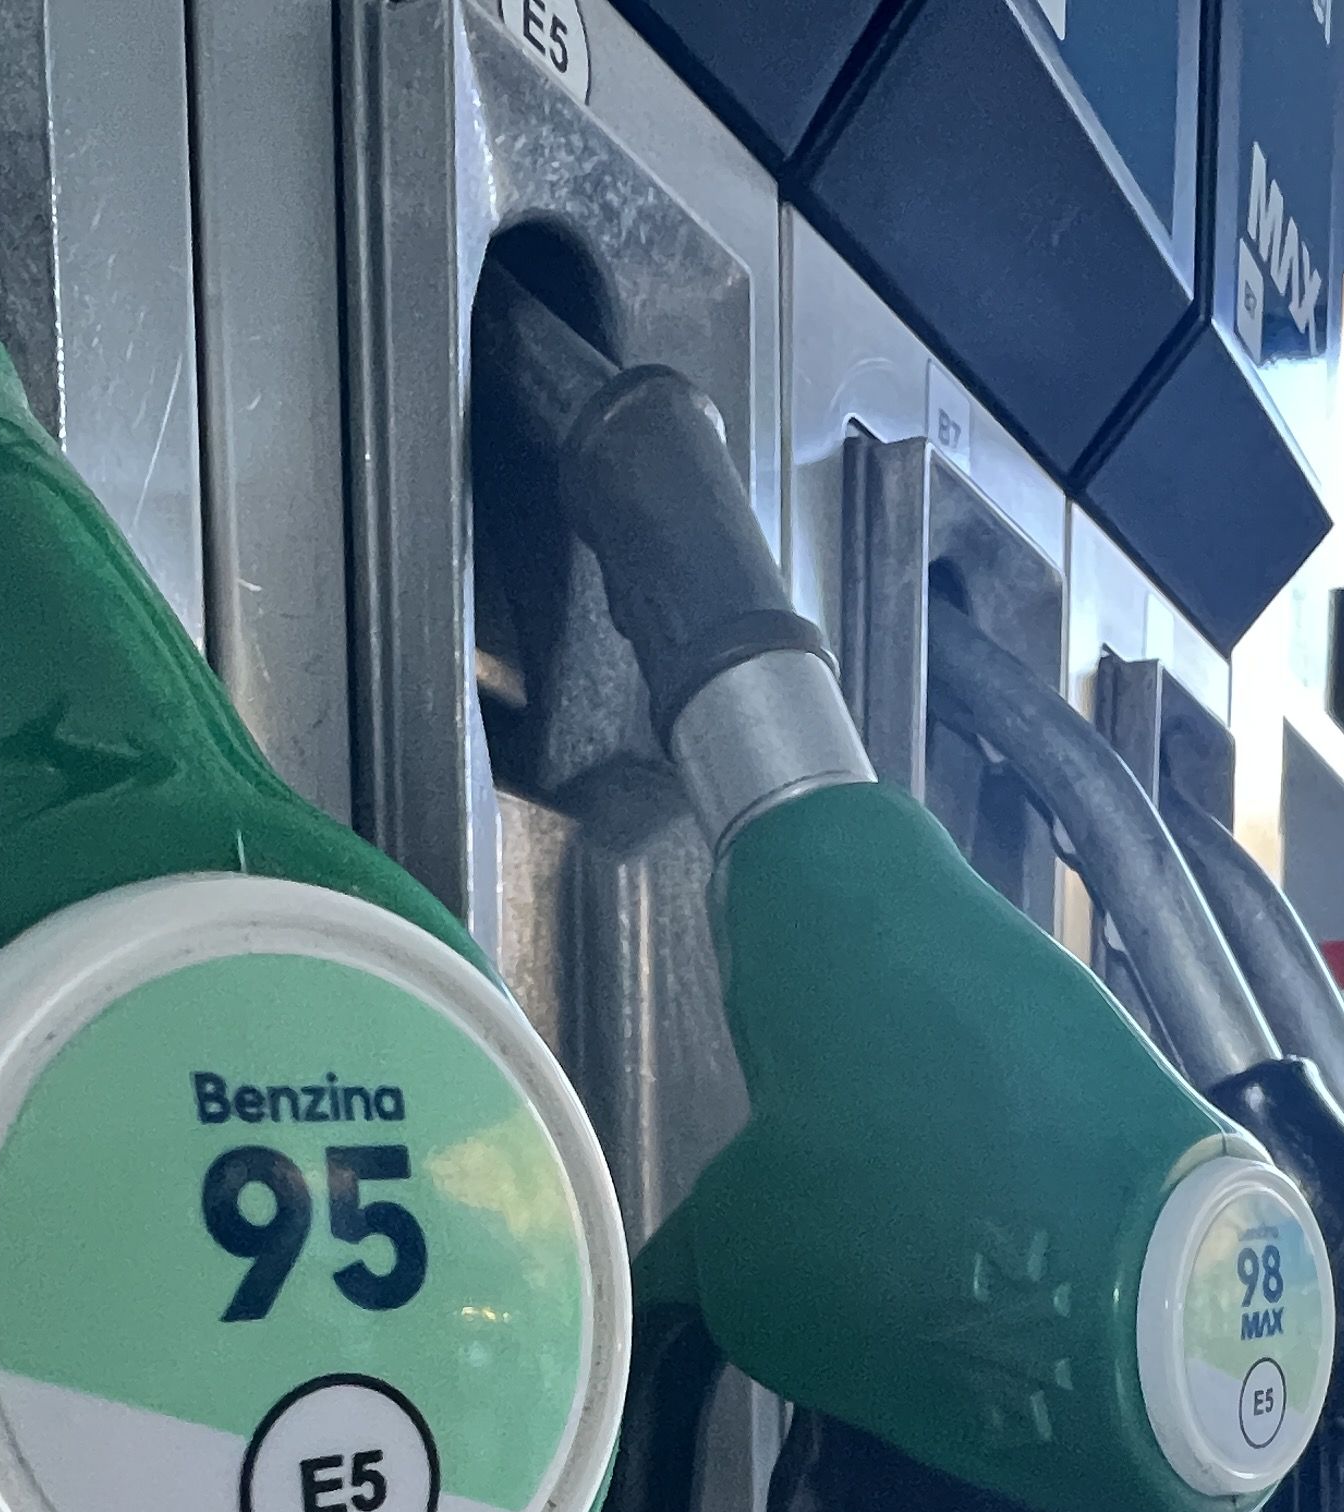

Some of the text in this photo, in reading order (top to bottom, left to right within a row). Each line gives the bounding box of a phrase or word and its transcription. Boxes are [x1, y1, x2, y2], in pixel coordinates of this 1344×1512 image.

[522, 0, 569, 73] E5
[1247, 140, 1322, 357] MAX
[938, 407, 962, 449] B7
[191, 1070, 406, 1124] Benzina
[202, 1144, 428, 1323] 95
[1237, 1245, 1284, 1308] 98
[1240, 1307, 1285, 1341] MAX
[1253, 1387, 1274, 1416] E5
